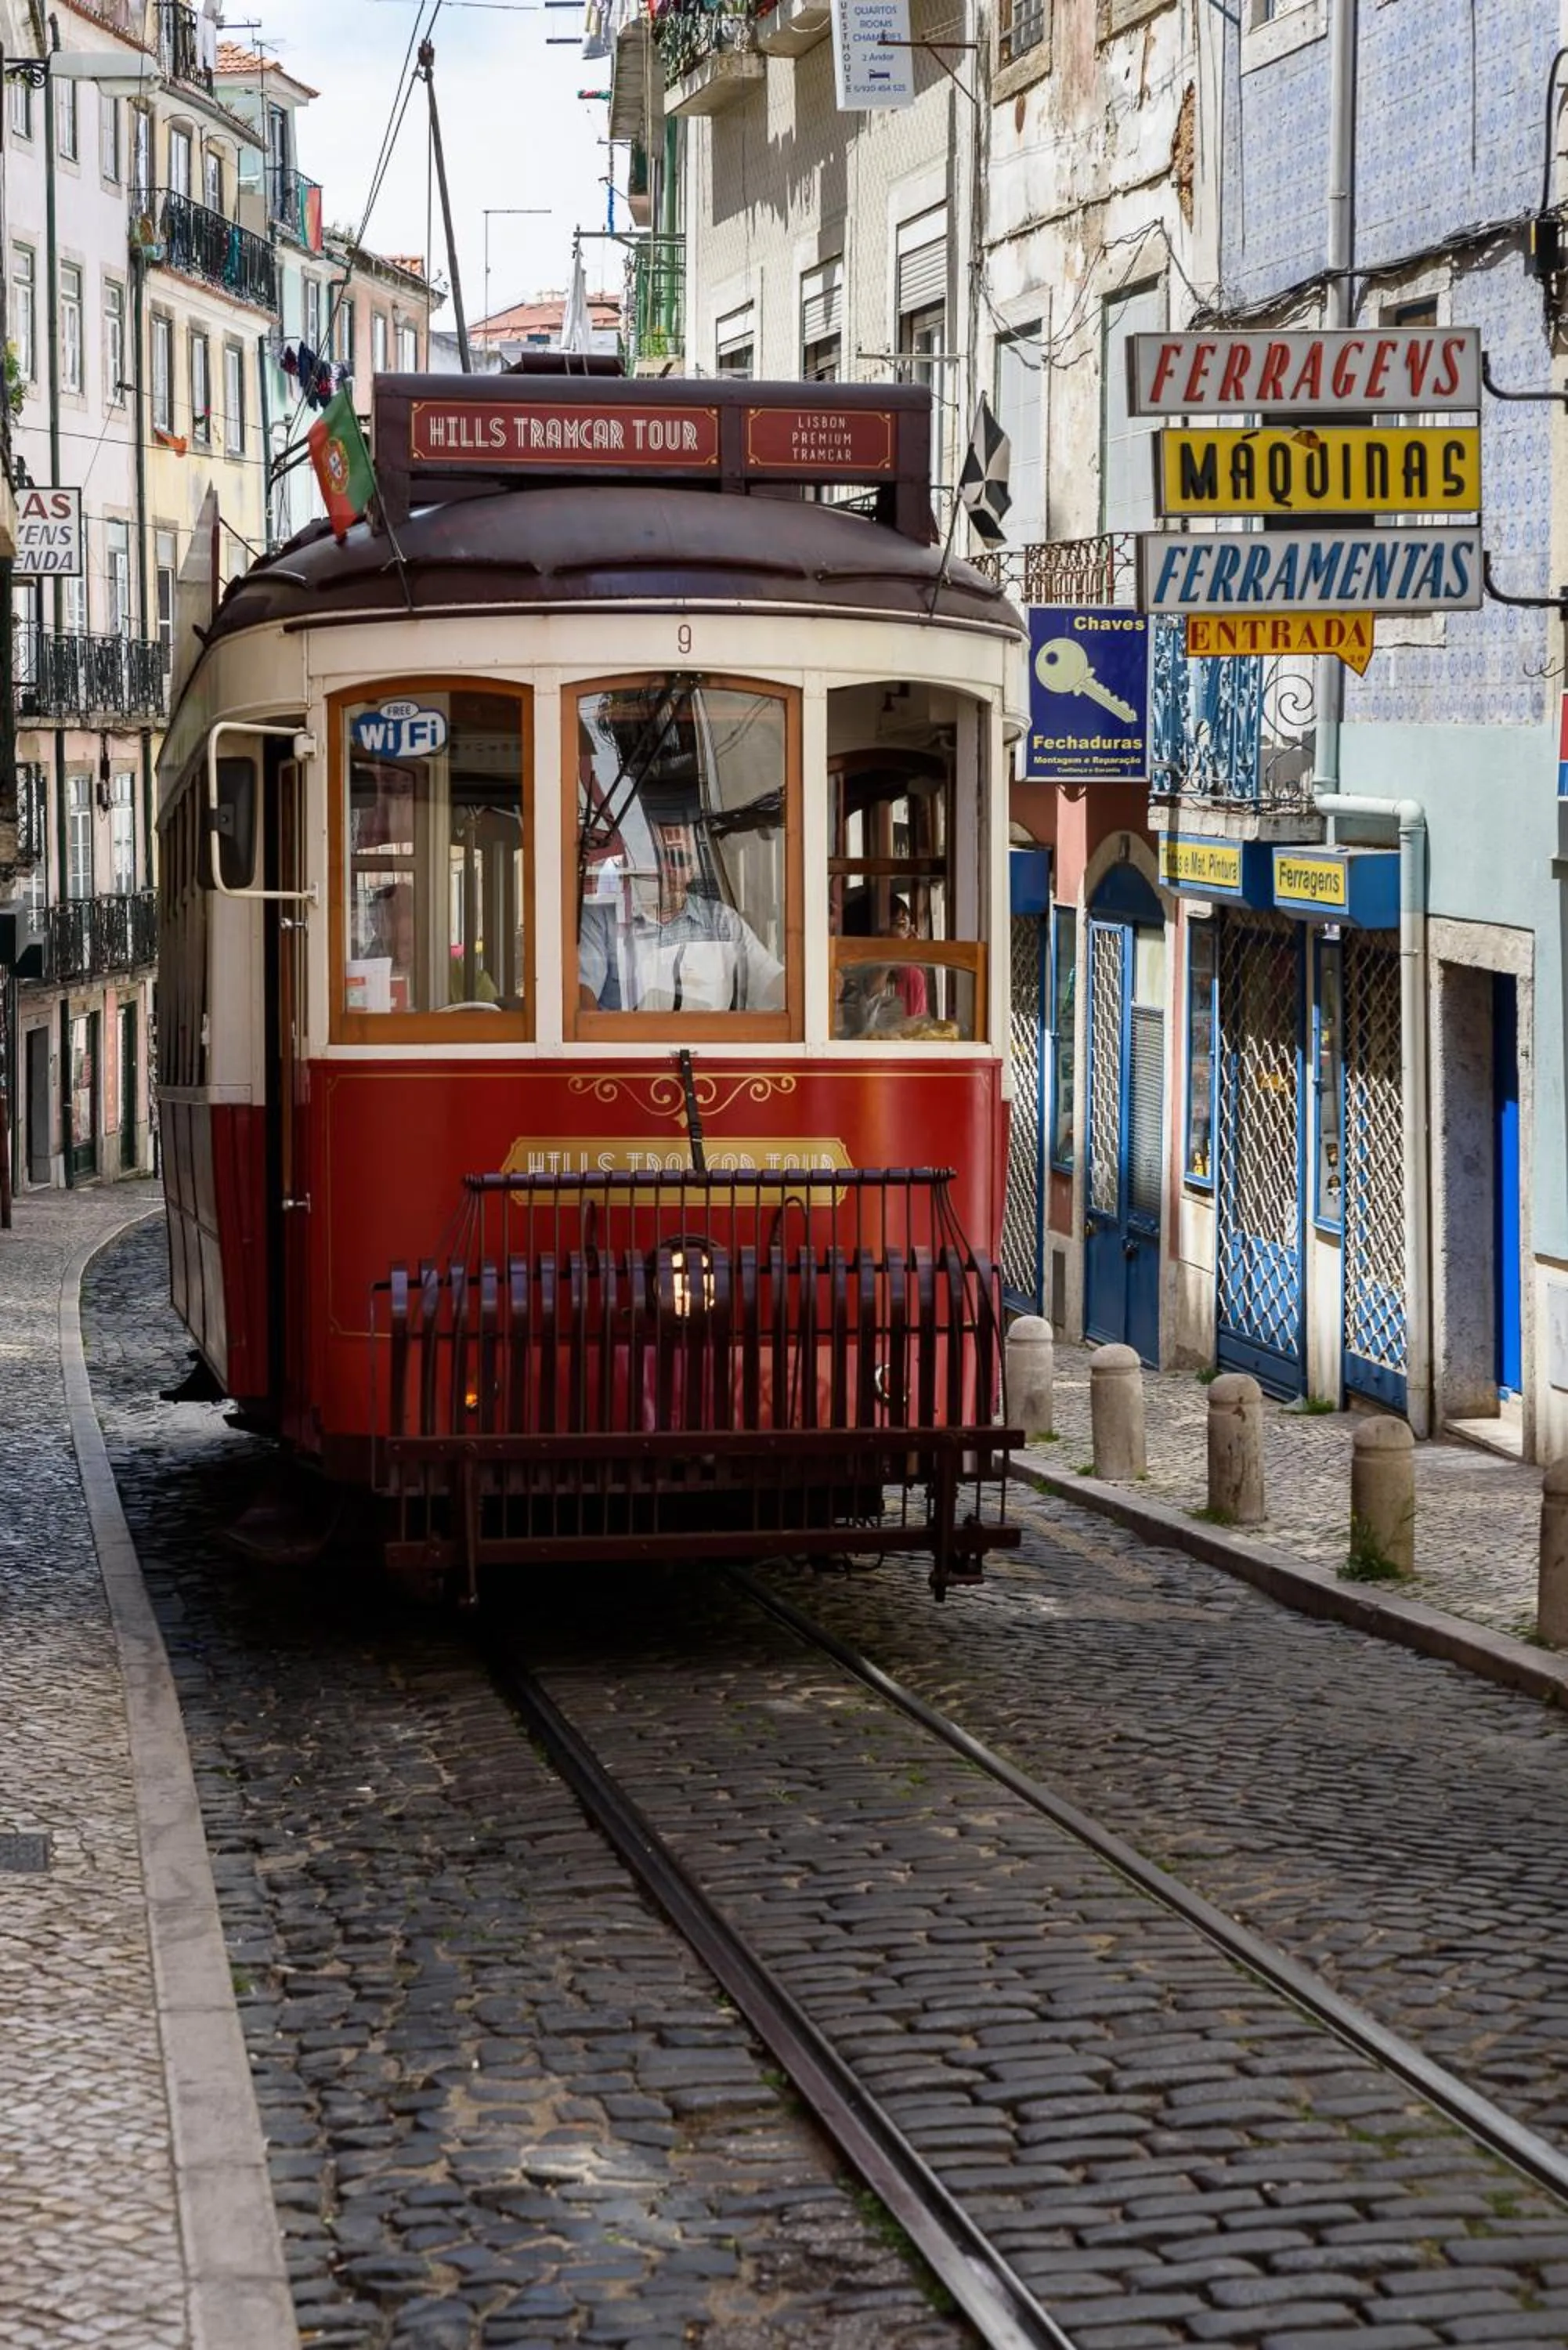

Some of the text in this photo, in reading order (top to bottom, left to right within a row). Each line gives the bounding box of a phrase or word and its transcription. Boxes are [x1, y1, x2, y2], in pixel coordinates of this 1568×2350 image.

[854, 5, 897, 16] QUARTOS
[860, 20, 893, 28] ROOMS
[852, 33, 902, 42] CHAMRES
[1149, 338, 1465, 403] FERRAGENS
[798, 415, 846, 428] LISBON
[429, 416, 699, 451] HILLS TRAMCAR TOUR
[792, 432, 851, 446] PREMIUM
[792, 447, 851, 462] TRAMCAR
[1180, 431, 1466, 507] MÁQUINAS
[22, 493, 71, 520] AS
[1153, 540, 1475, 603] FERRAMENTAS
[1074, 616, 1144, 631] Chaves
[678, 624, 692, 654] 9
[1190, 618, 1367, 650] ENTRADA
[387, 706, 411, 715] FREE
[1033, 735, 1143, 750] Fechaduras
[1278, 861, 1340, 897] Ferragens
